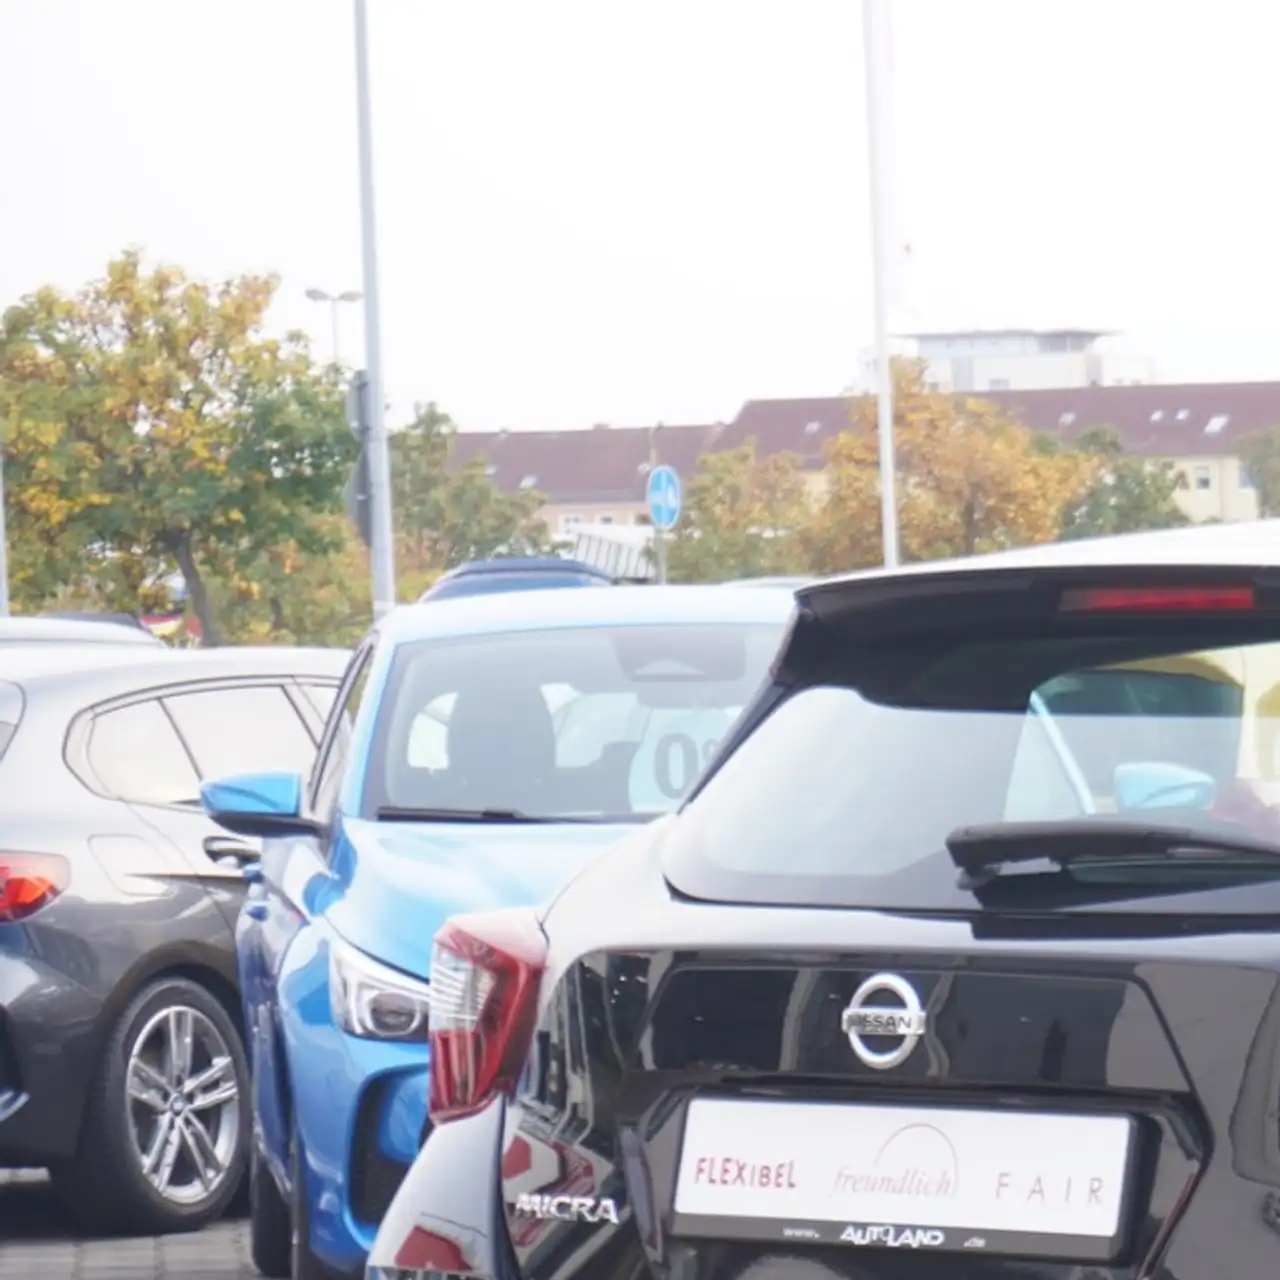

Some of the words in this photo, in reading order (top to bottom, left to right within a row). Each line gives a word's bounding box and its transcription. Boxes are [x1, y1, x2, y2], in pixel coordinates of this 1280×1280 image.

[696, 1157, 796, 1188] FLEXIBEL
[829, 1165, 951, 1196] freundlich
[515, 1193, 619, 1224] MICRA
[840, 1225, 945, 1248] AUTOLAND
